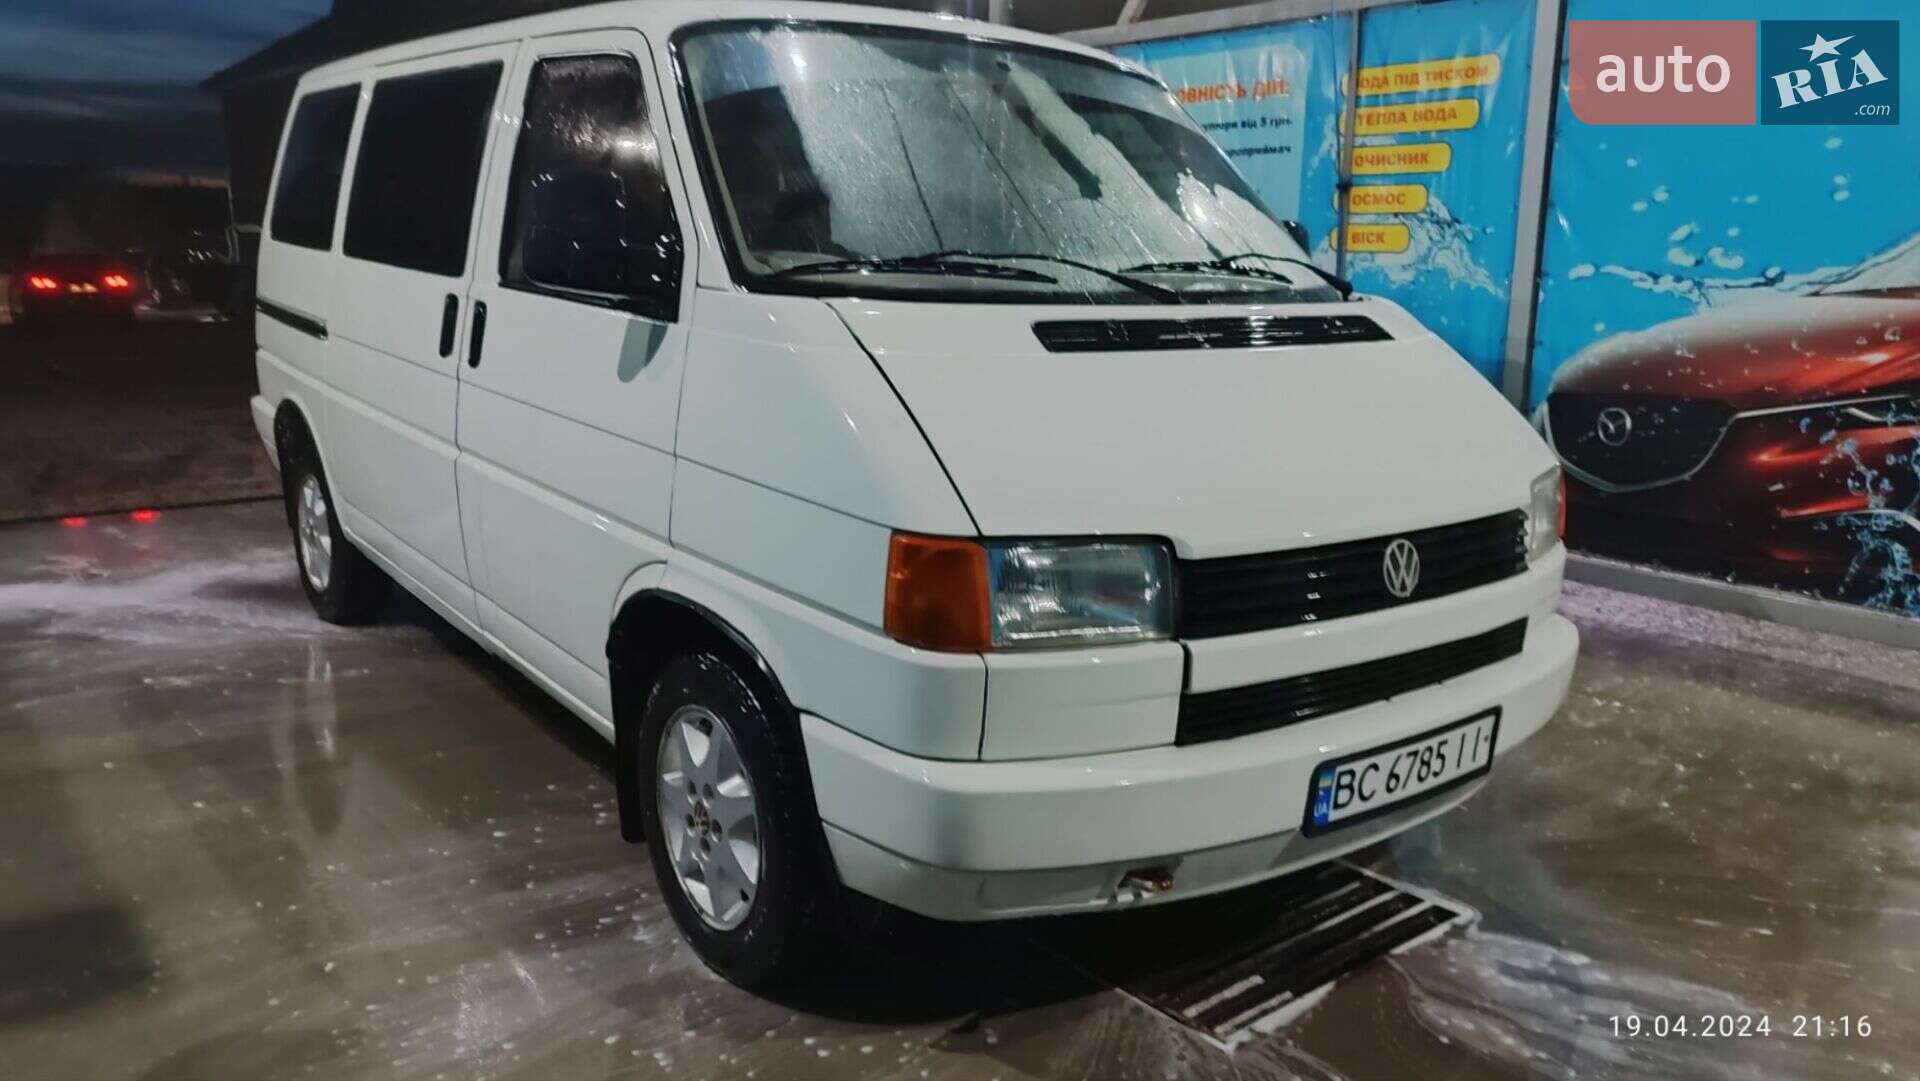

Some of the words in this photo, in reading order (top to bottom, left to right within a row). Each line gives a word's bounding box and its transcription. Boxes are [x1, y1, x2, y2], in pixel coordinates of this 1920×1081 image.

[1357, 77, 1389, 90] ОДА
[1394, 71, 1420, 86] ПІД
[1358, 110, 1408, 126] ТЕПЛА
[1413, 107, 1458, 123] ВОДА
[1354, 151, 1430, 168] ОЧИСНИК
[1352, 192, 1406, 206] ОСМОС
[1351, 231, 1386, 245] ВІСК
[1332, 762, 1380, 810] BC
[1385, 738, 1448, 794] 6785
[1313, 801, 1328, 817] UA
